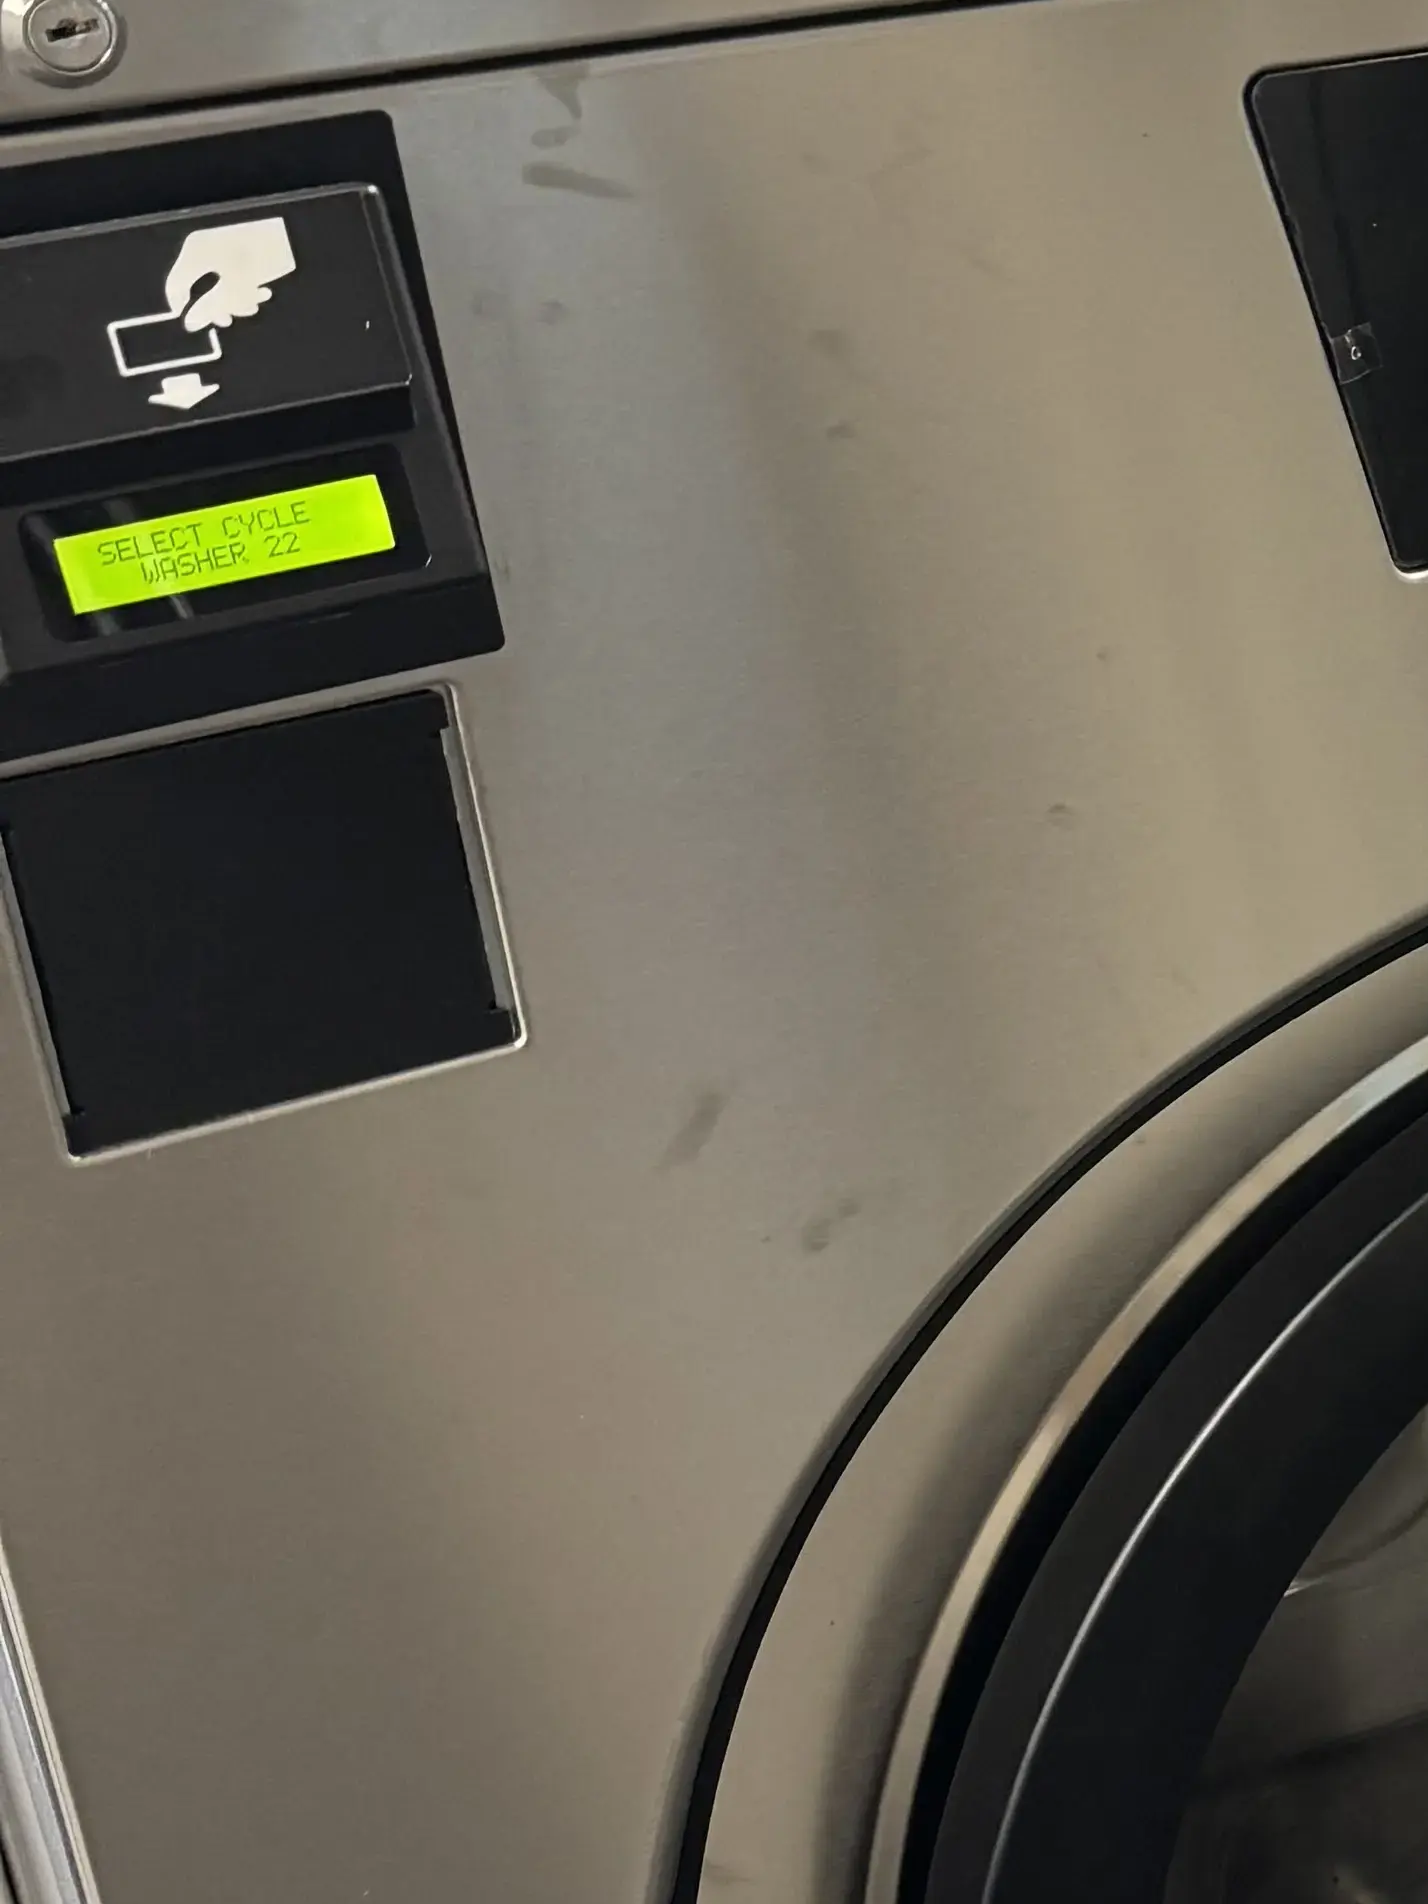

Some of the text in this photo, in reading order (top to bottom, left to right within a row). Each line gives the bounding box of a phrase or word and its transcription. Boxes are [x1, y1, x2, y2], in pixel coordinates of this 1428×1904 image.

[97, 501, 310, 566] SELECT CYCLE
[140, 531, 301, 585] WASHER 22
